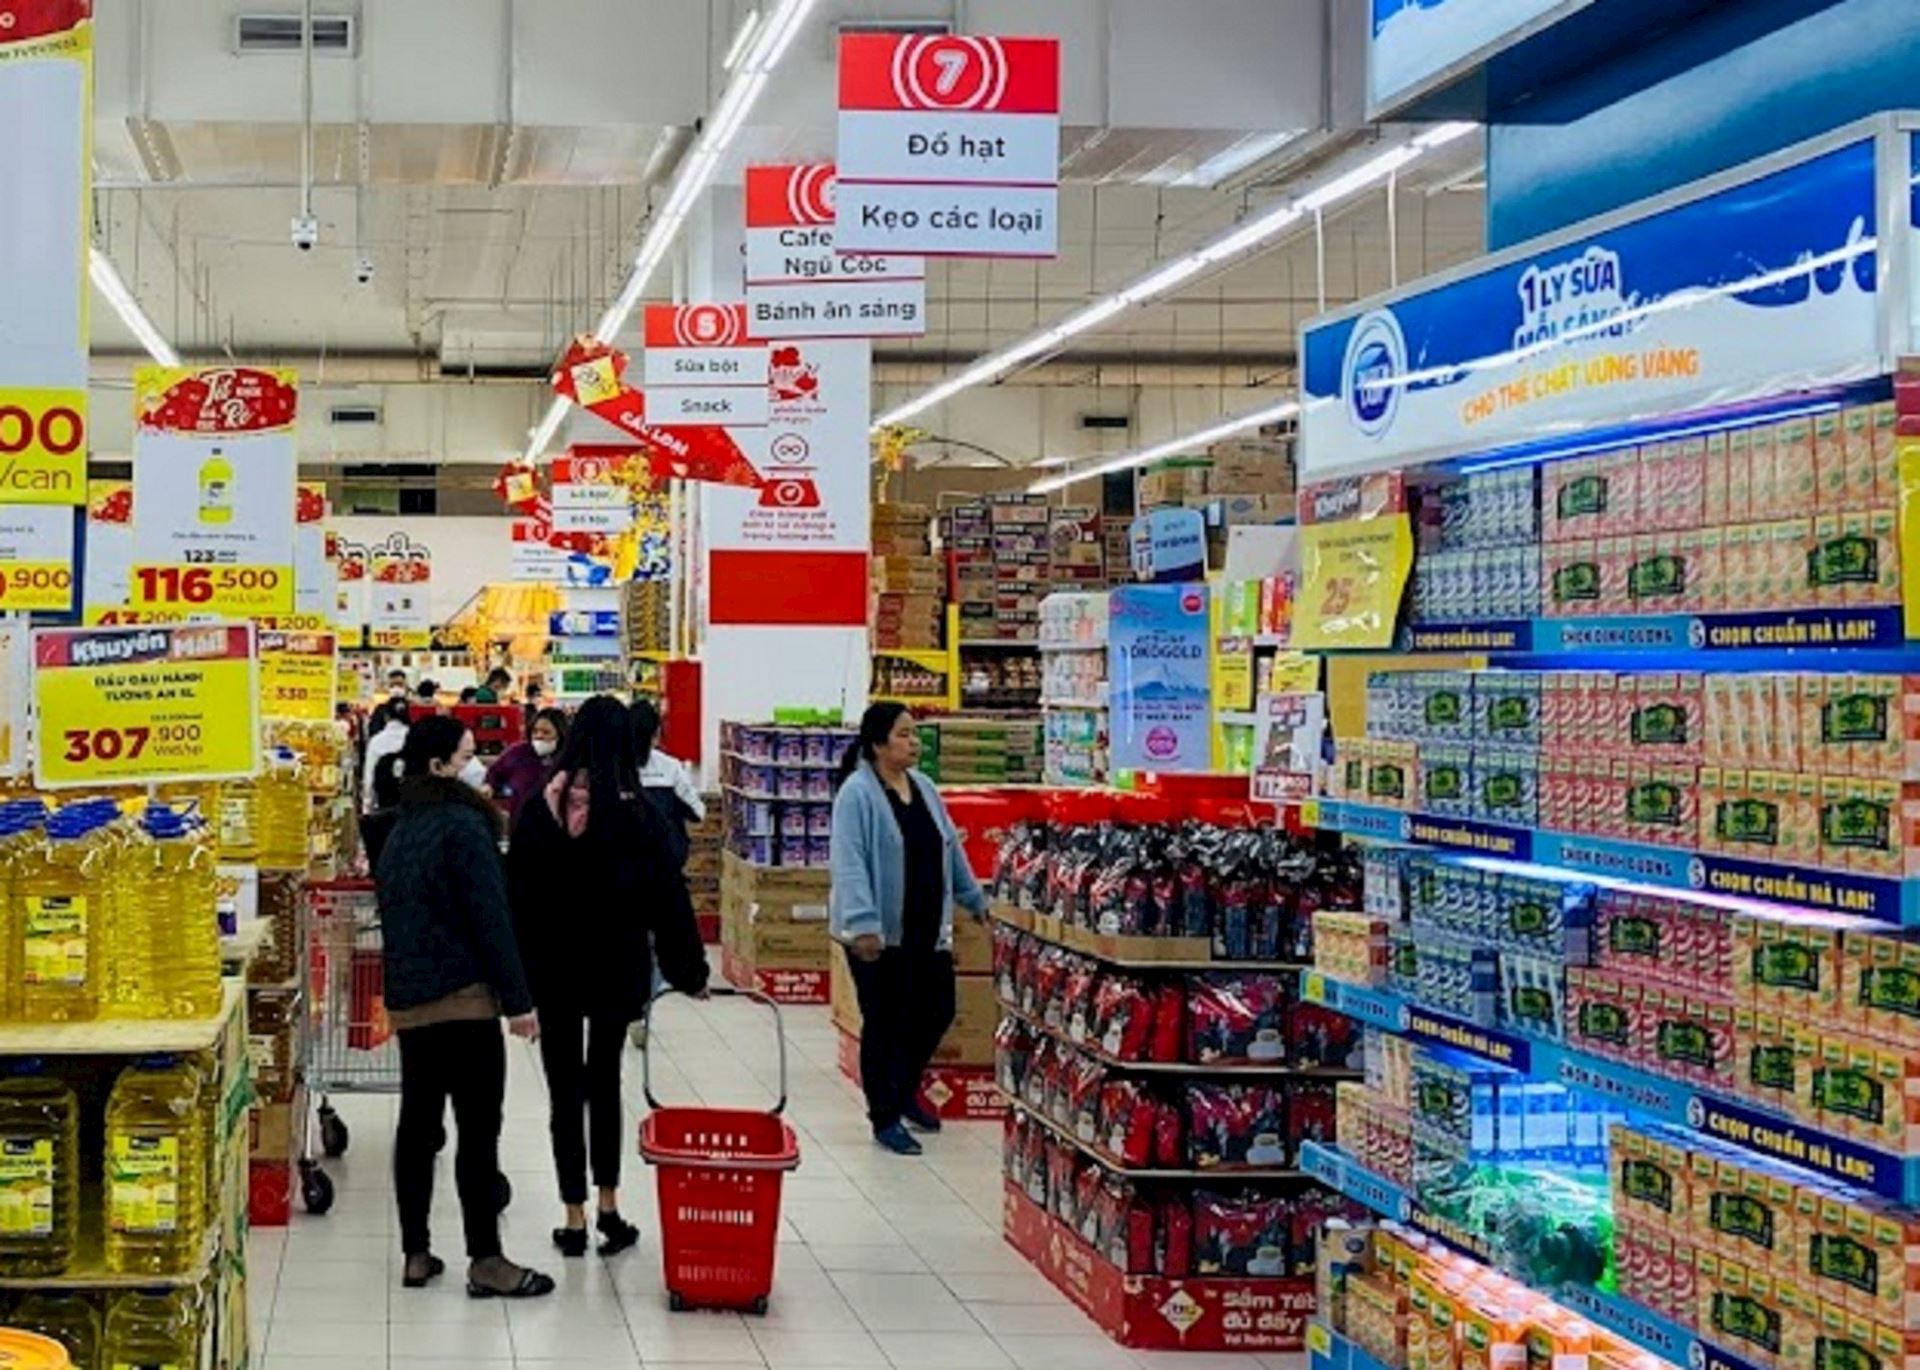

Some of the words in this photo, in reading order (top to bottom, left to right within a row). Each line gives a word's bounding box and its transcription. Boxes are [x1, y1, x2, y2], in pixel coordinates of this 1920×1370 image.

[933, 49, 968, 95] 7
[960, 135, 1005, 163] hạt
[862, 204, 919, 233] Kẹo
[929, 205, 979, 230] các
[989, 207, 1043, 235] loại
[1523, 275, 1535, 313] 1
[1541, 271, 1565, 307] LY
[1570, 255, 1616, 297] SỮA
[756, 301, 815, 321] Bánh
[859, 298, 916, 321] sáng
[1642, 341, 1698, 379] VÀNG
[72, 631, 167, 663] Khuyến
[1710, 626, 1751, 648] CHỌN
[1836, 619, 1876, 640] LAN!
[1710, 869, 1752, 894] CHỌN
[1837, 887, 1876, 912] LAN!
[1709, 1112, 1750, 1141] CHỌN
